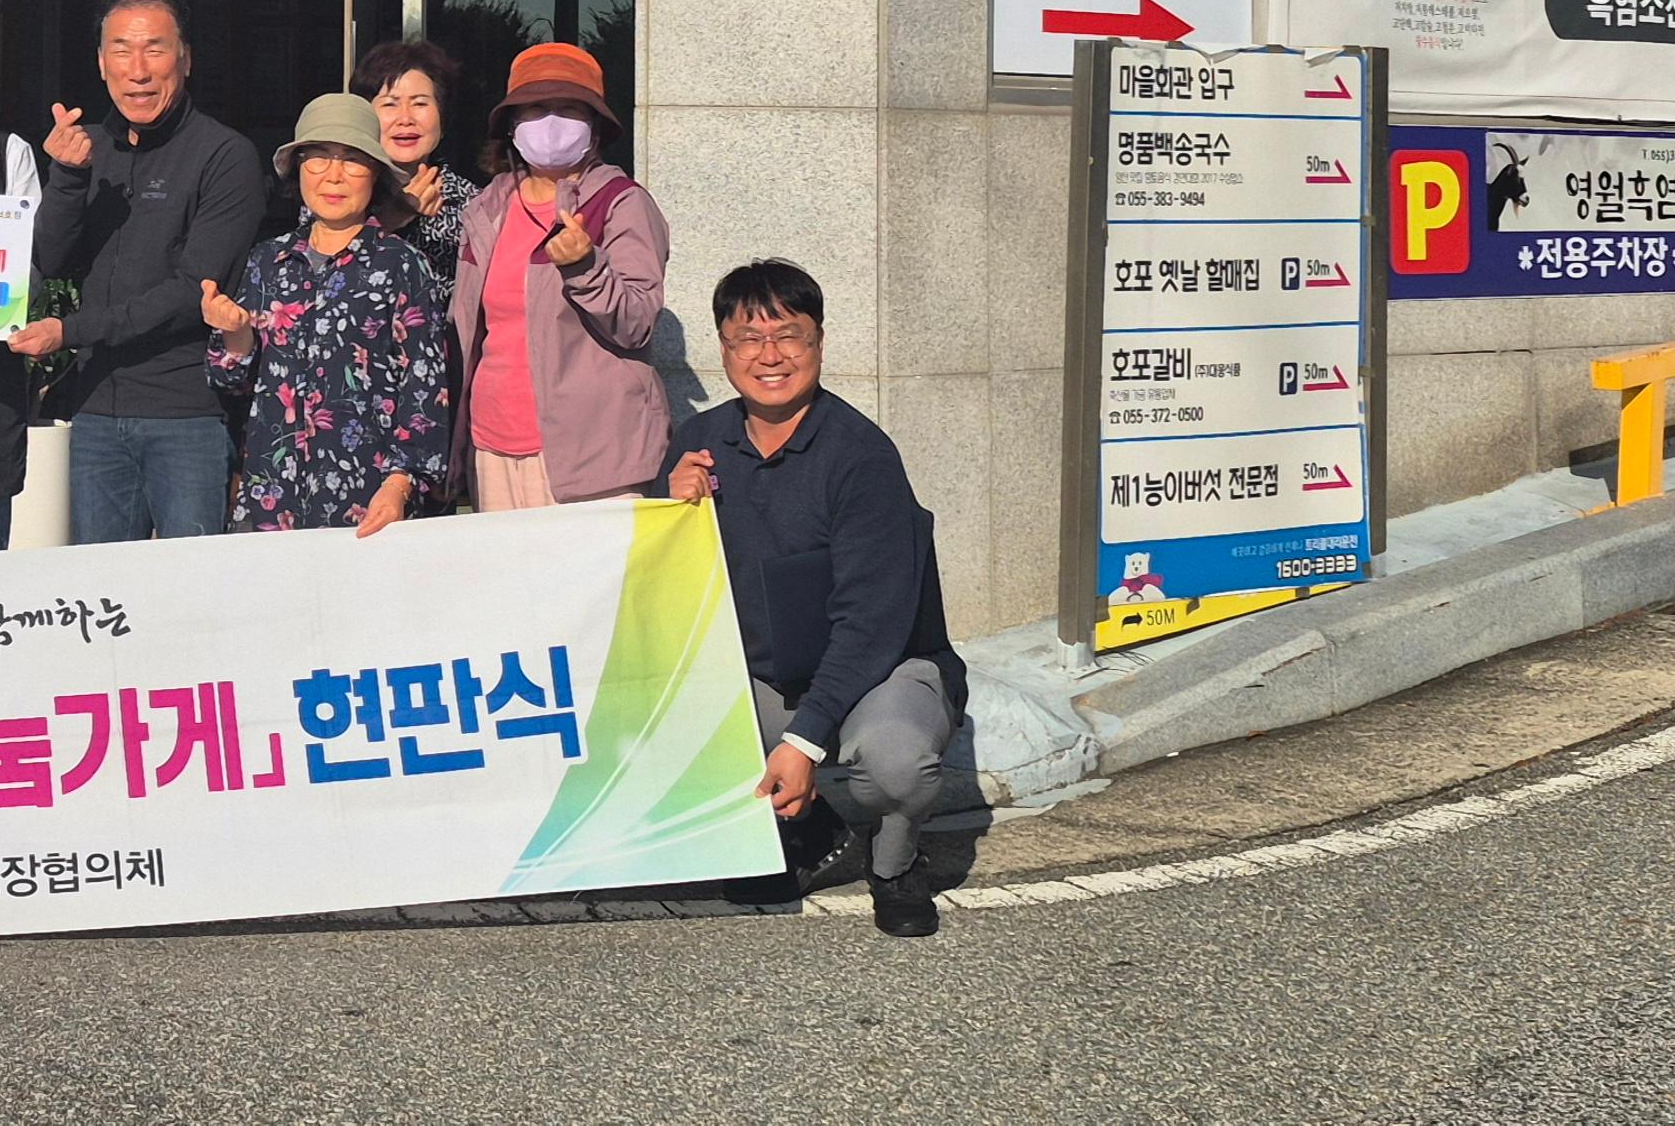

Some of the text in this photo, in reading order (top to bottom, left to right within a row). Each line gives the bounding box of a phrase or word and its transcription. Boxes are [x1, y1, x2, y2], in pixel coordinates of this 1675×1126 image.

[1120, 65, 1235, 100] 마을회관 입구
[1118, 132, 1231, 166] 명품백송국수
[1306, 156, 1330, 172] 50m
[1128, 191, 1205, 206] 055-383-9494
[1401, 161, 1460, 261] P
[1113, 258, 1260, 292] 호포 옛날 할매집
[1306, 260, 1330, 276] 50m
[1110, 348, 1192, 382] 호포갈비
[1304, 363, 1328, 379] 50m
[1123, 407, 1204, 424] 055-372-0500
[1303, 463, 1328, 480] 50m
[1111, 464, 1279, 507] 제1능이버섯 전문점
[1276, 554, 1357, 578] 1600-3333
[1146, 609, 1175, 626] 50M
[292, 645, 582, 784] 현판식
